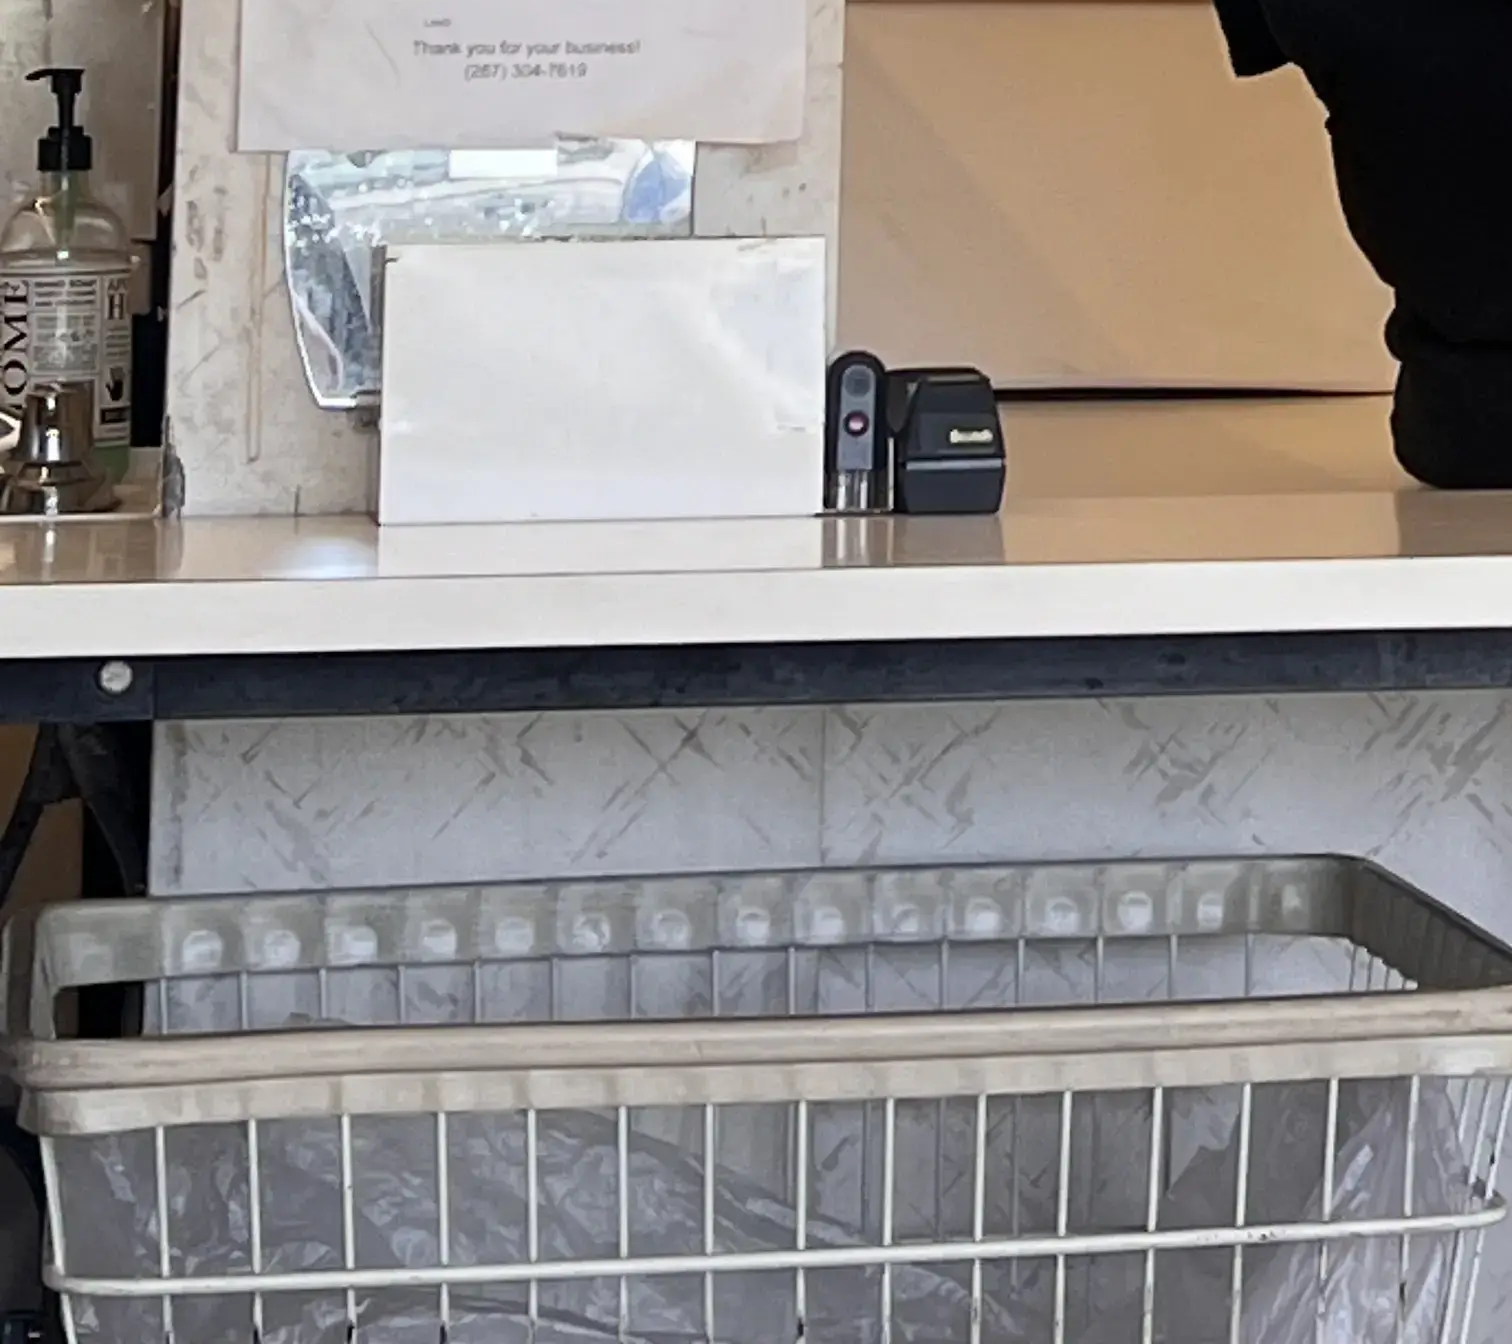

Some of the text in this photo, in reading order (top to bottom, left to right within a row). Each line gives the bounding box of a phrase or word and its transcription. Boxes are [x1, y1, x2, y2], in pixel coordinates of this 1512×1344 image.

[413, 39, 462, 56] Thank
[466, 42, 496, 59] you
[499, 39, 523, 56] for
[526, 42, 560, 60] your
